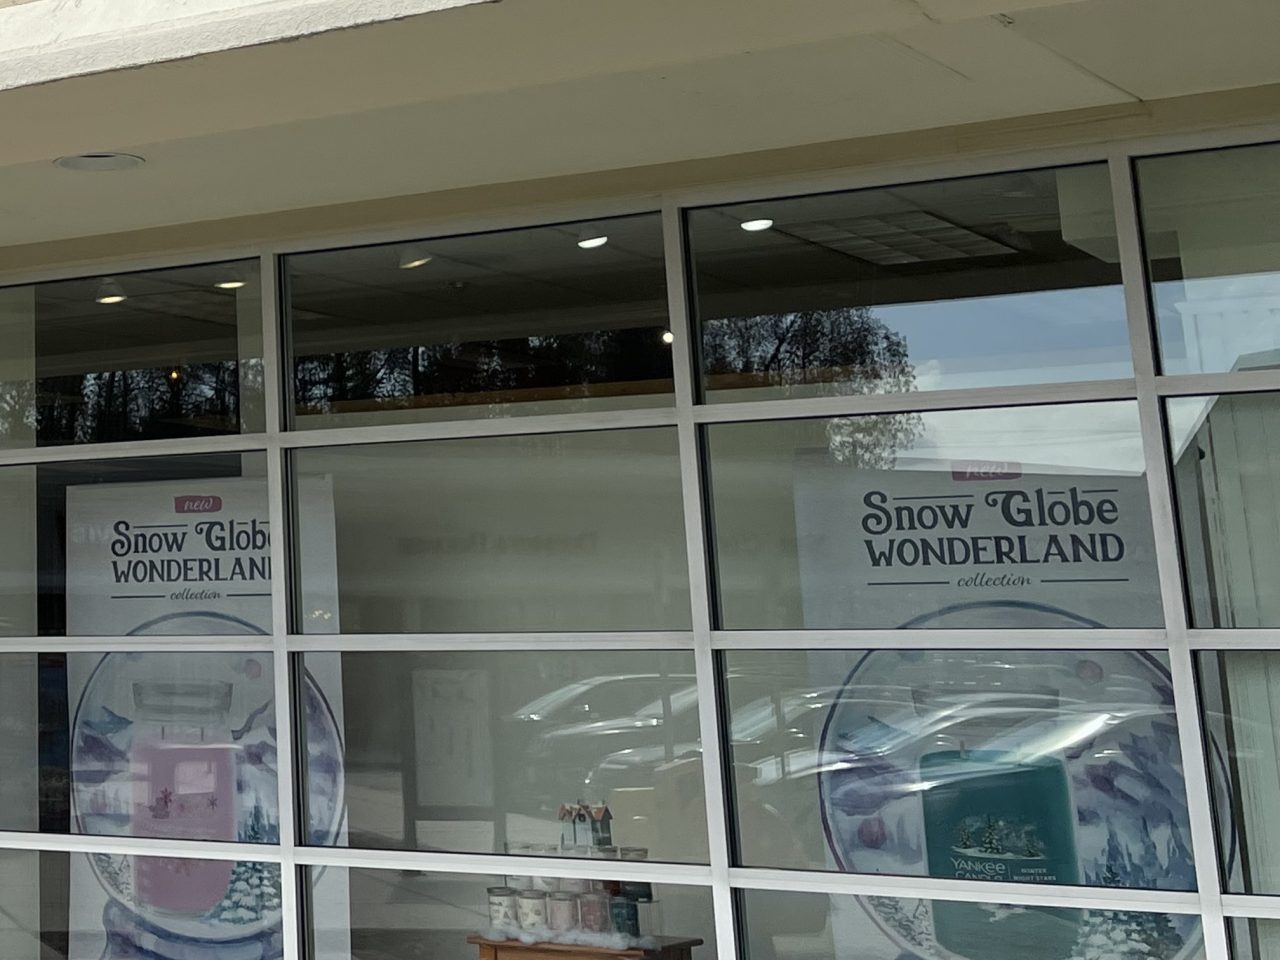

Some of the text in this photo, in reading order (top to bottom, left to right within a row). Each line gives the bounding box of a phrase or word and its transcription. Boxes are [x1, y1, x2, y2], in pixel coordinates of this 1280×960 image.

[183, 496, 214, 511] new
[861, 487, 1119, 535] Snow Globe
[111, 520, 188, 557] Snow
[194, 518, 271, 551] Glob
[864, 533, 1125, 567] WONDERLAND
[111, 556, 271, 583] WONDERLAN
[957, 572, 1032, 587] collection
[170, 588, 221, 600] collection
